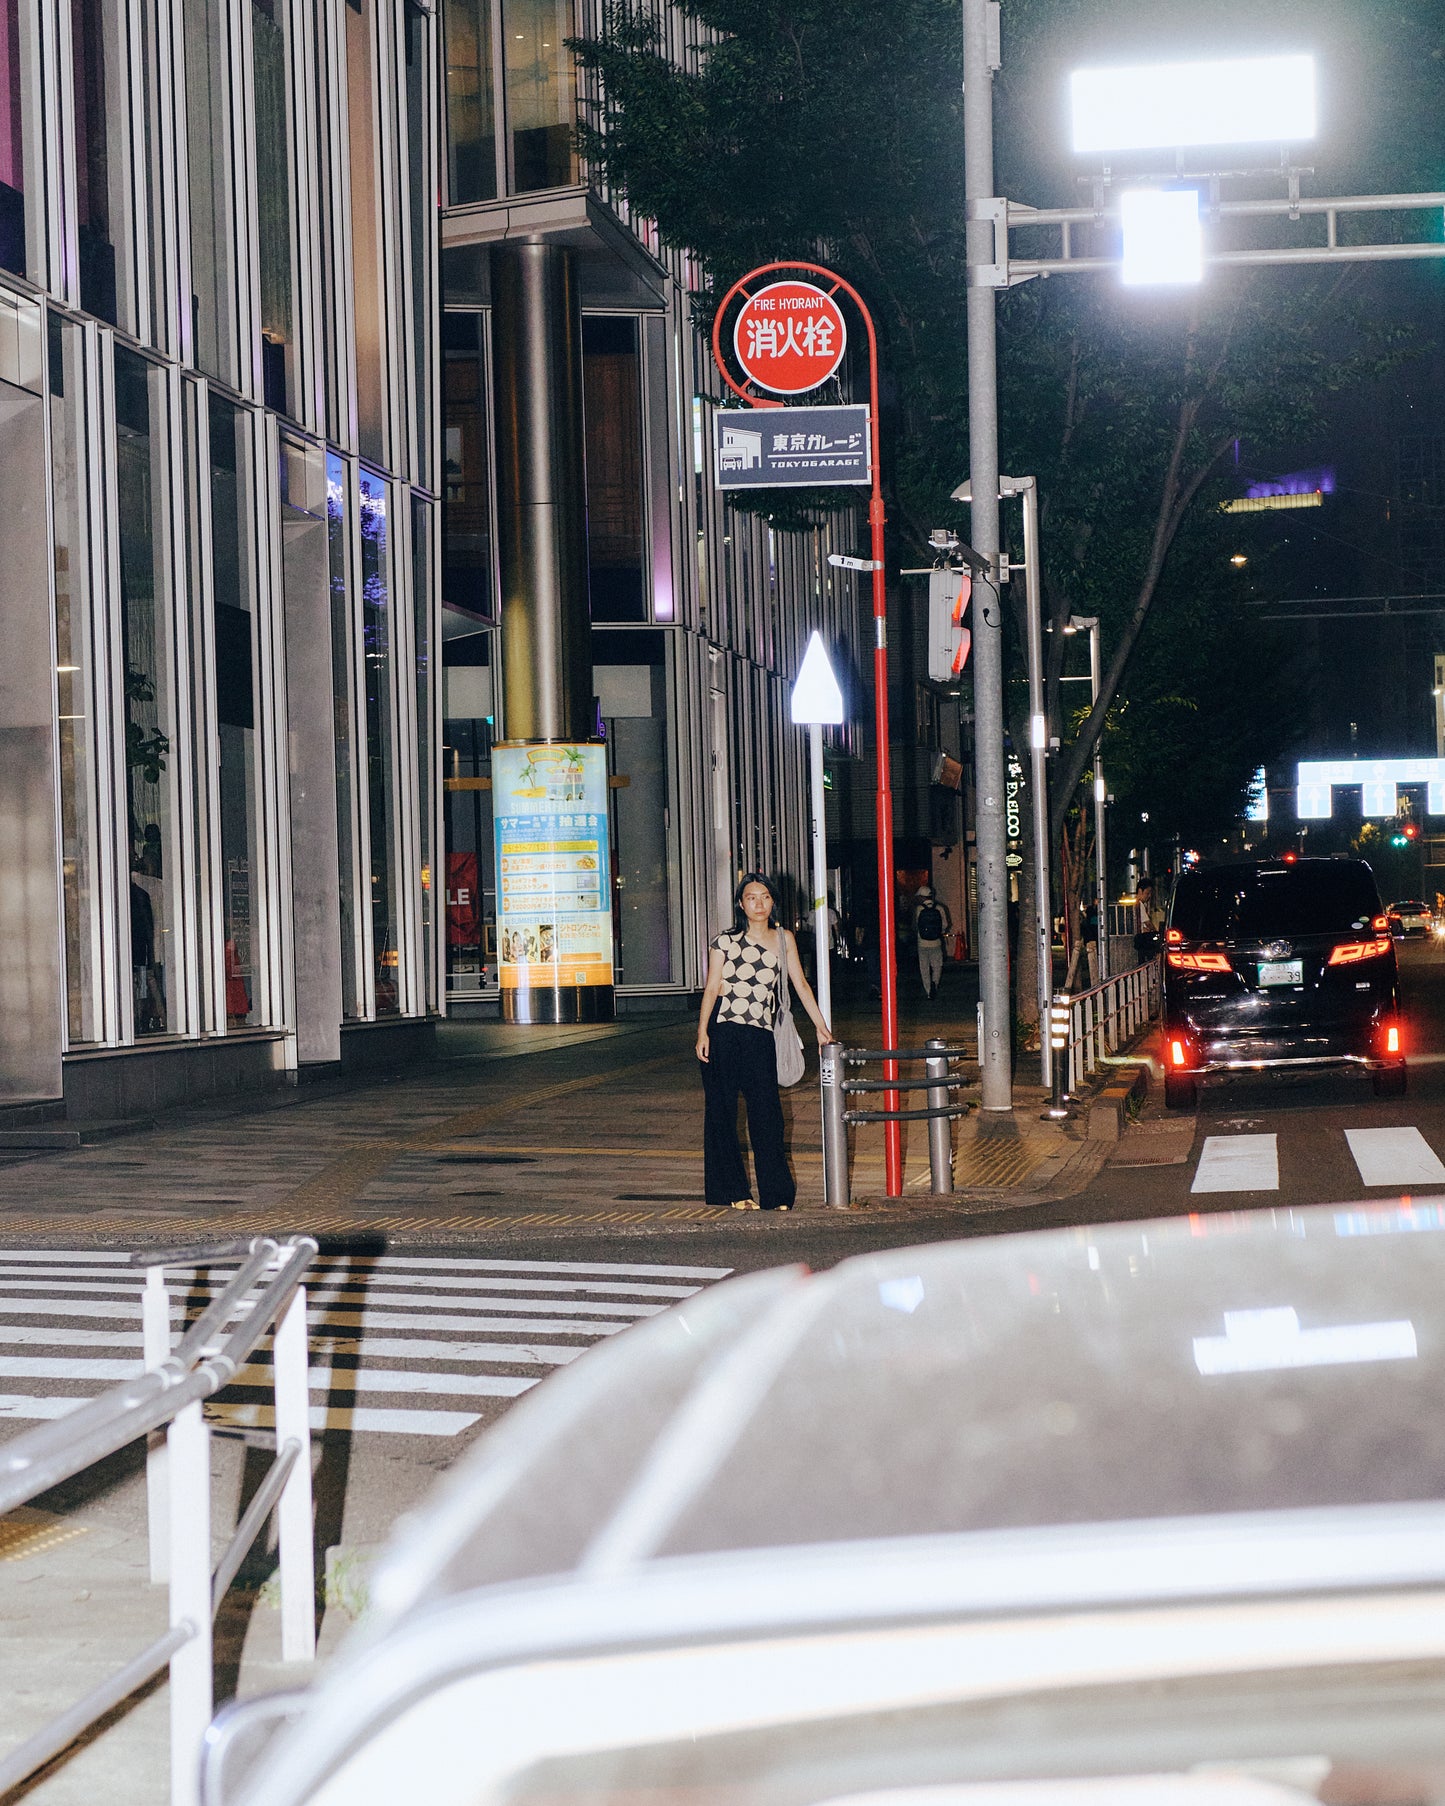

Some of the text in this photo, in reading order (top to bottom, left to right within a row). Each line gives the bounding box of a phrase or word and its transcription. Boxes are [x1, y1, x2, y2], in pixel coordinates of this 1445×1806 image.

[754, 296, 825, 311] FIRE HYDRANT
[746, 315, 836, 359] 消火栓
[772, 432, 862, 452] 東京ガレージ
[770, 458, 860, 469] TOKYOGARAGE
[840, 557, 845, 565] 1
[1006, 781, 1020, 838] EXELCO
